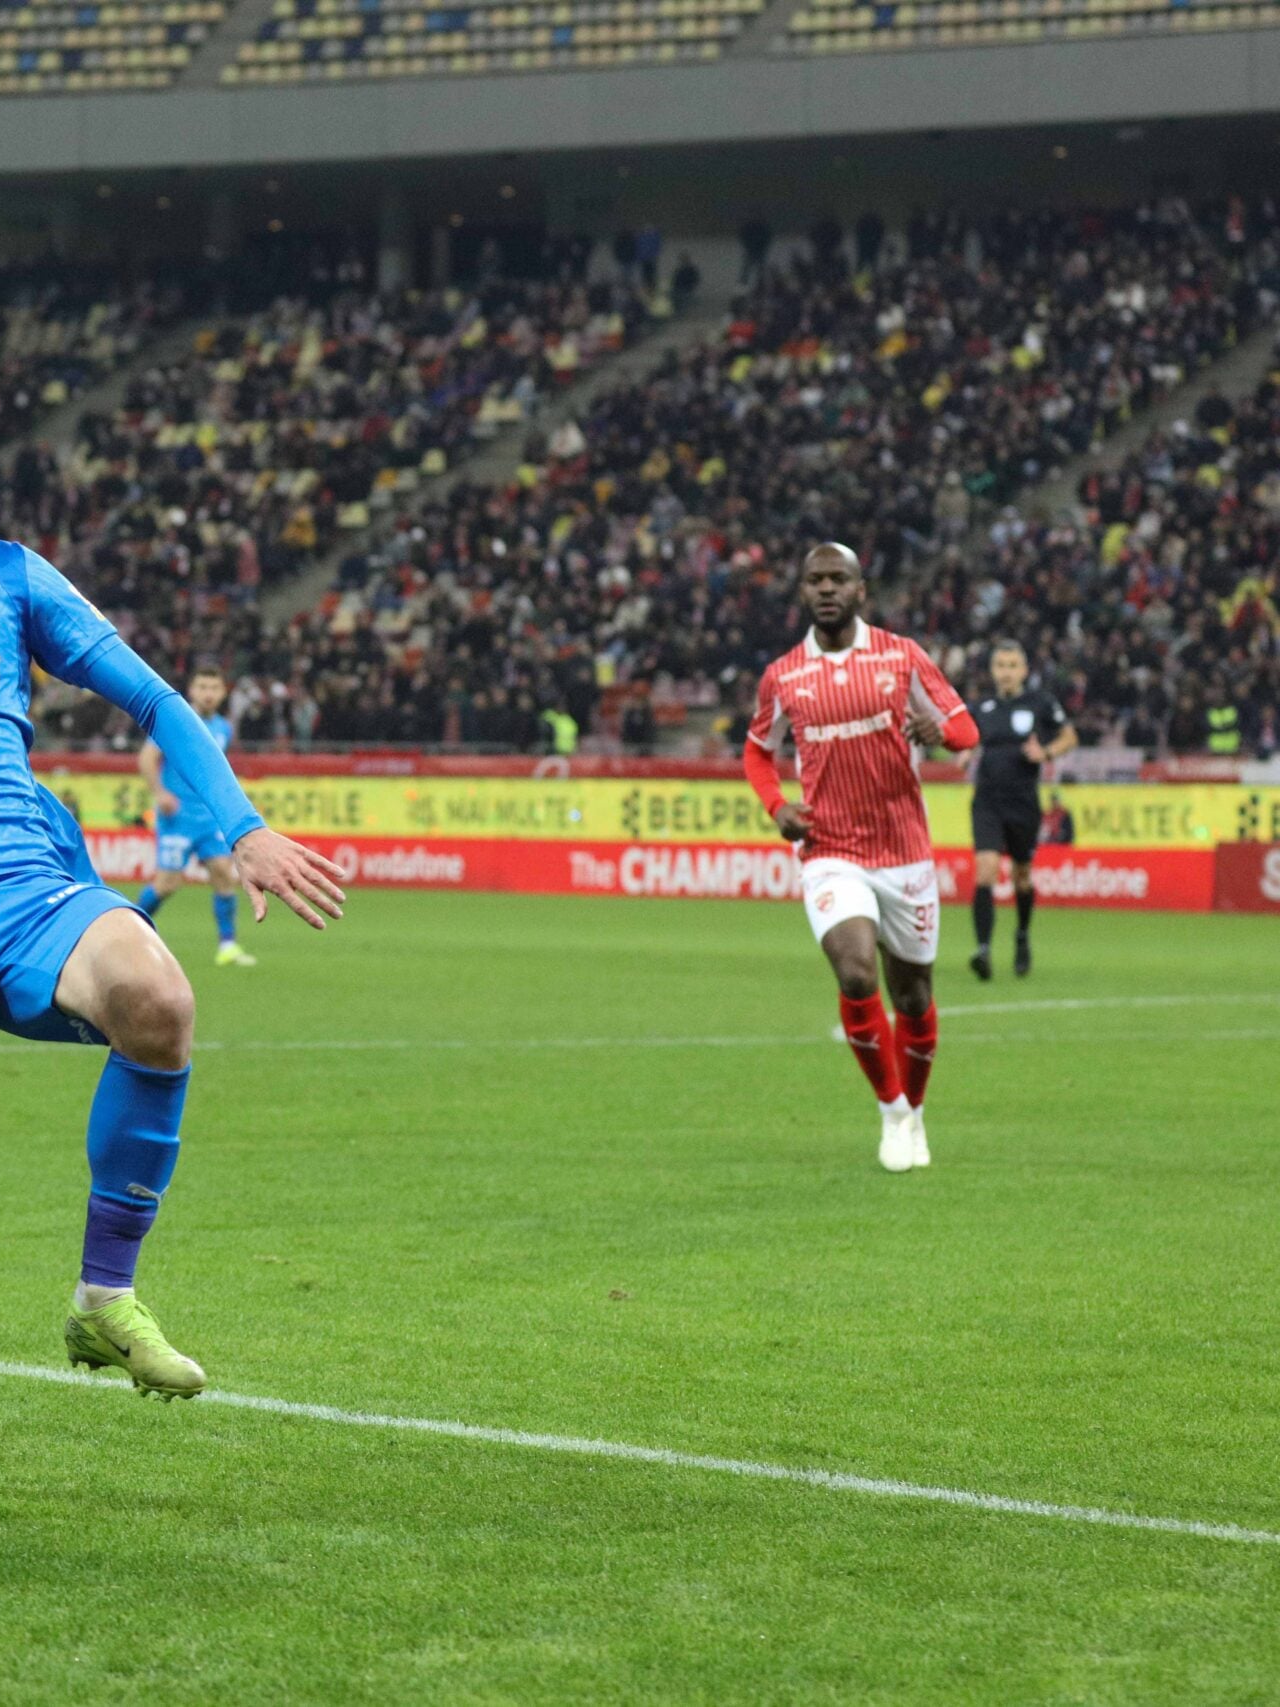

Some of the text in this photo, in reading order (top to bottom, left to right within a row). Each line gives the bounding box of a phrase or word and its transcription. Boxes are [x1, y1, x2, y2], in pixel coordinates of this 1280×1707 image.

[804, 709, 892, 742] SUPERBET
[361, 846, 465, 882] vodafone
[620, 847, 805, 896] CHAMPIO
